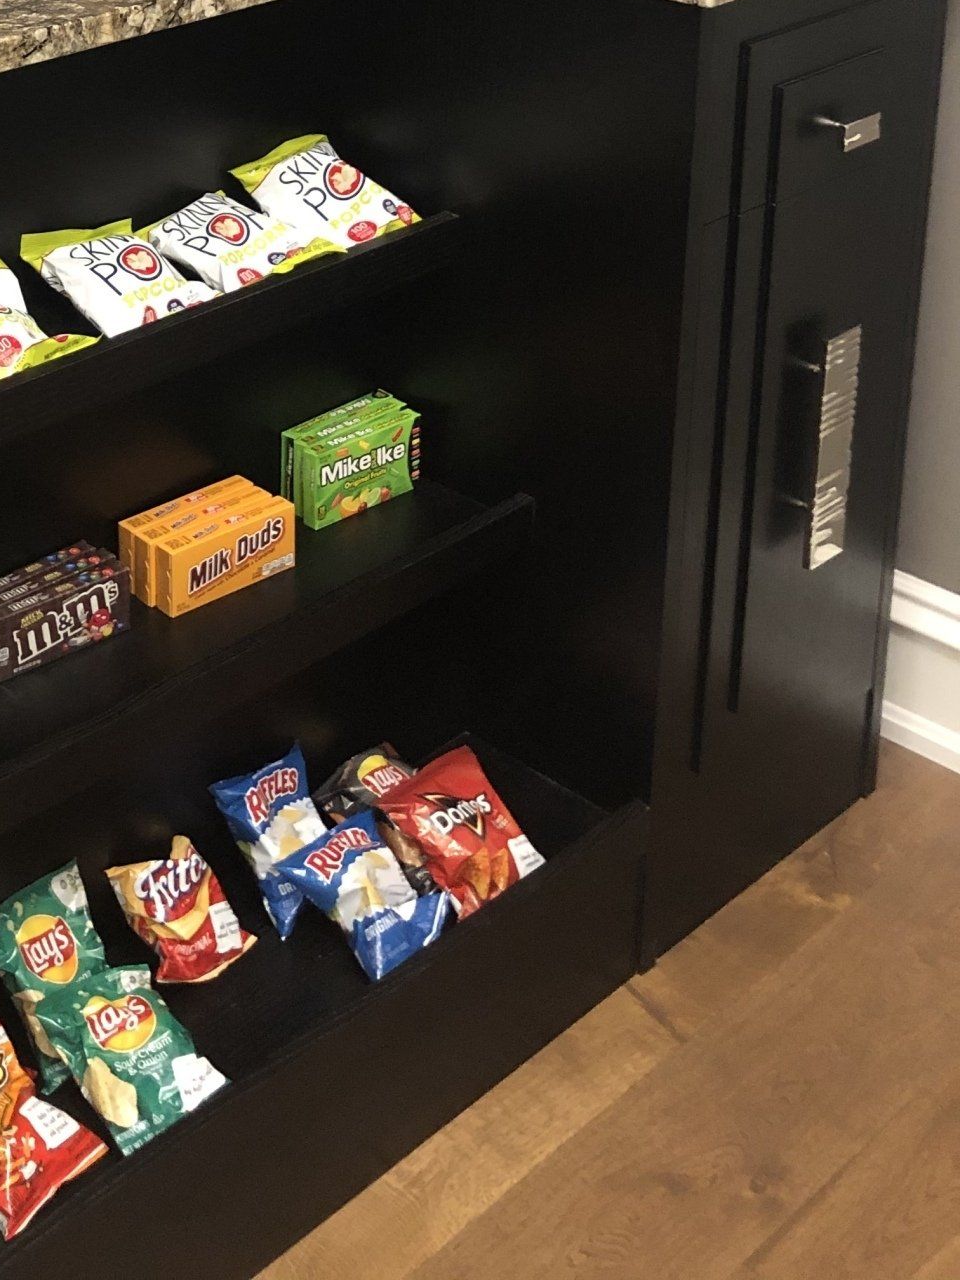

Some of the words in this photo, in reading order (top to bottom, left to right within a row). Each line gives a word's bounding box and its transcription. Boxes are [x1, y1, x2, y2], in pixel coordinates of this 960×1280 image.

[320, 455, 373, 487] Mike
[376, 443, 406, 467] Ike
[188, 549, 231, 595] Milk
[236, 517, 284, 565] Duds
[428, 794, 492, 836] Doritos
